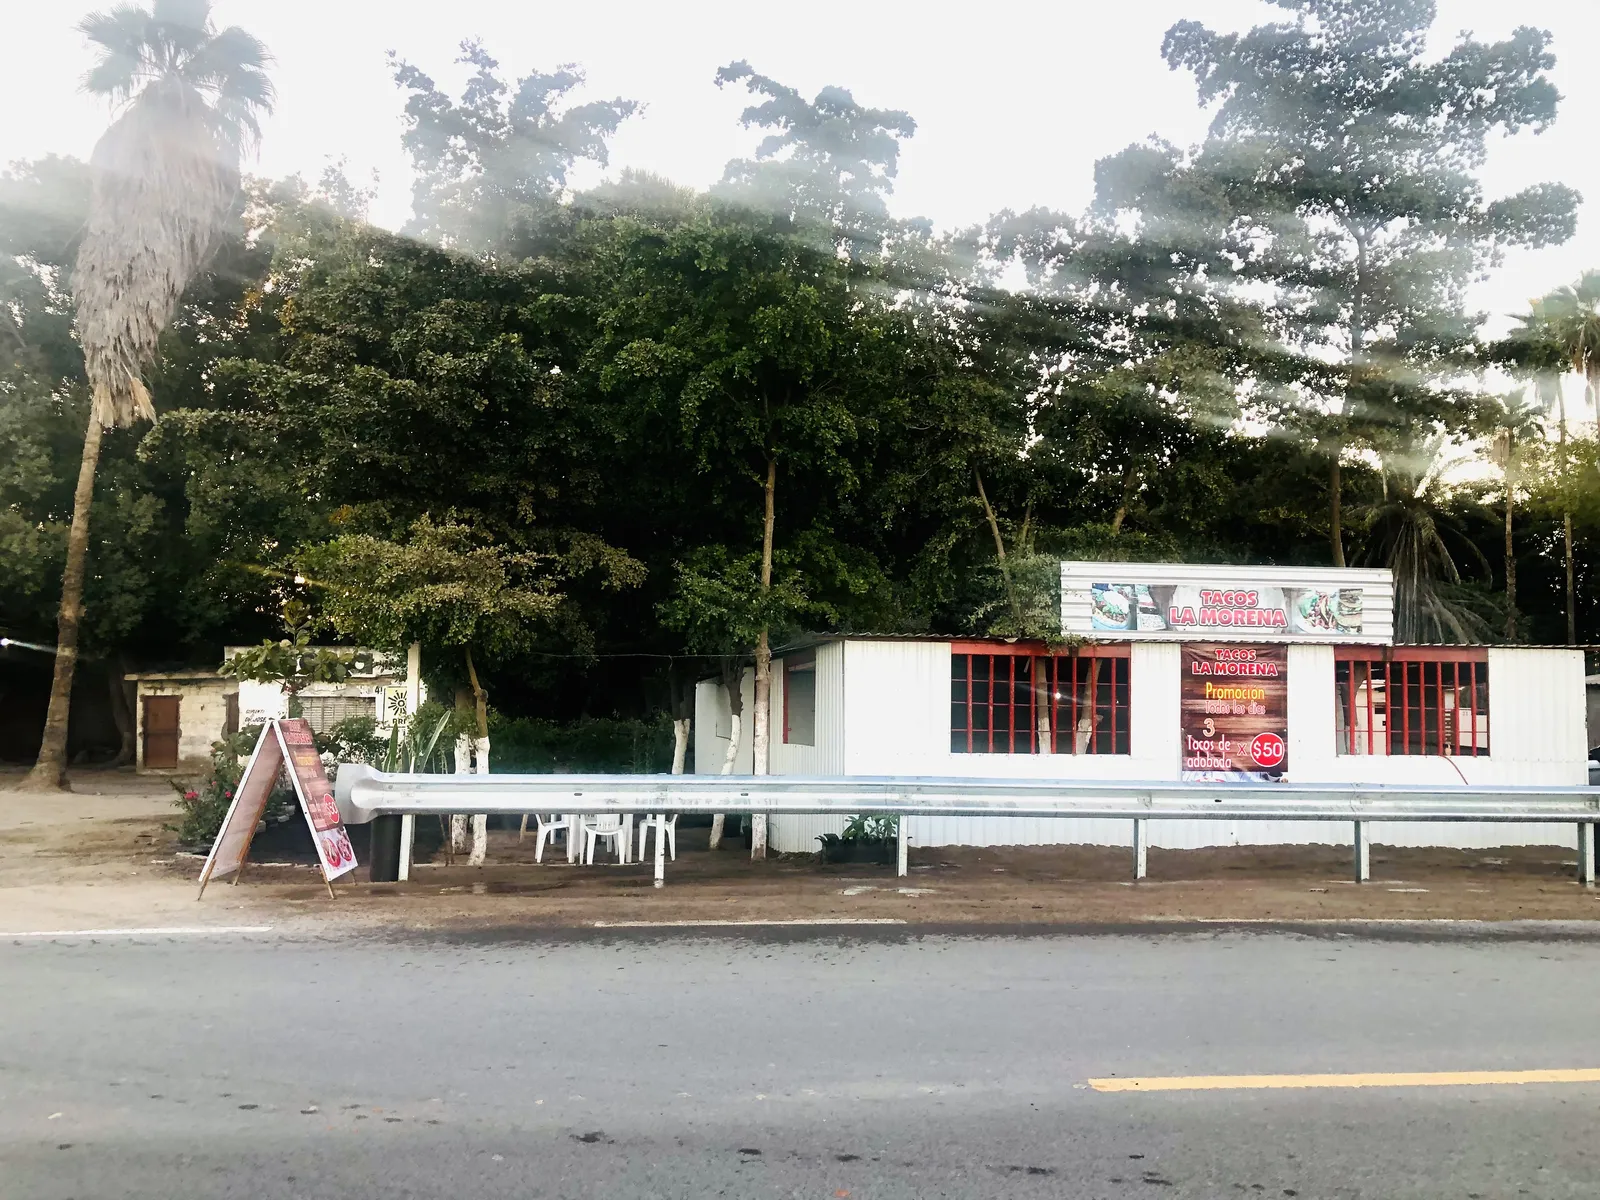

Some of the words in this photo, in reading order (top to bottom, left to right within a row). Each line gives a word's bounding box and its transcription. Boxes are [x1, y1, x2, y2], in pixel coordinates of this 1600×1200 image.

[1200, 590, 1258, 607] TACOS
[1169, 607, 1197, 626] LA
[1199, 608, 1288, 627] MORENA
[1215, 649, 1256, 661] TACOS
[1192, 662, 1212, 674] LA
[1214, 662, 1278, 676] MORENA
[1205, 682, 1265, 699] Promoción
[1205, 699, 1230, 714] Todos
[1232, 699, 1245, 714] los
[1202, 718, 1216, 737] 3
[1187, 735, 1214, 751] Tacos
[1218, 734, 1231, 751] de
[1252, 741, 1283, 759] $50
[1186, 751, 1232, 768] adobada
